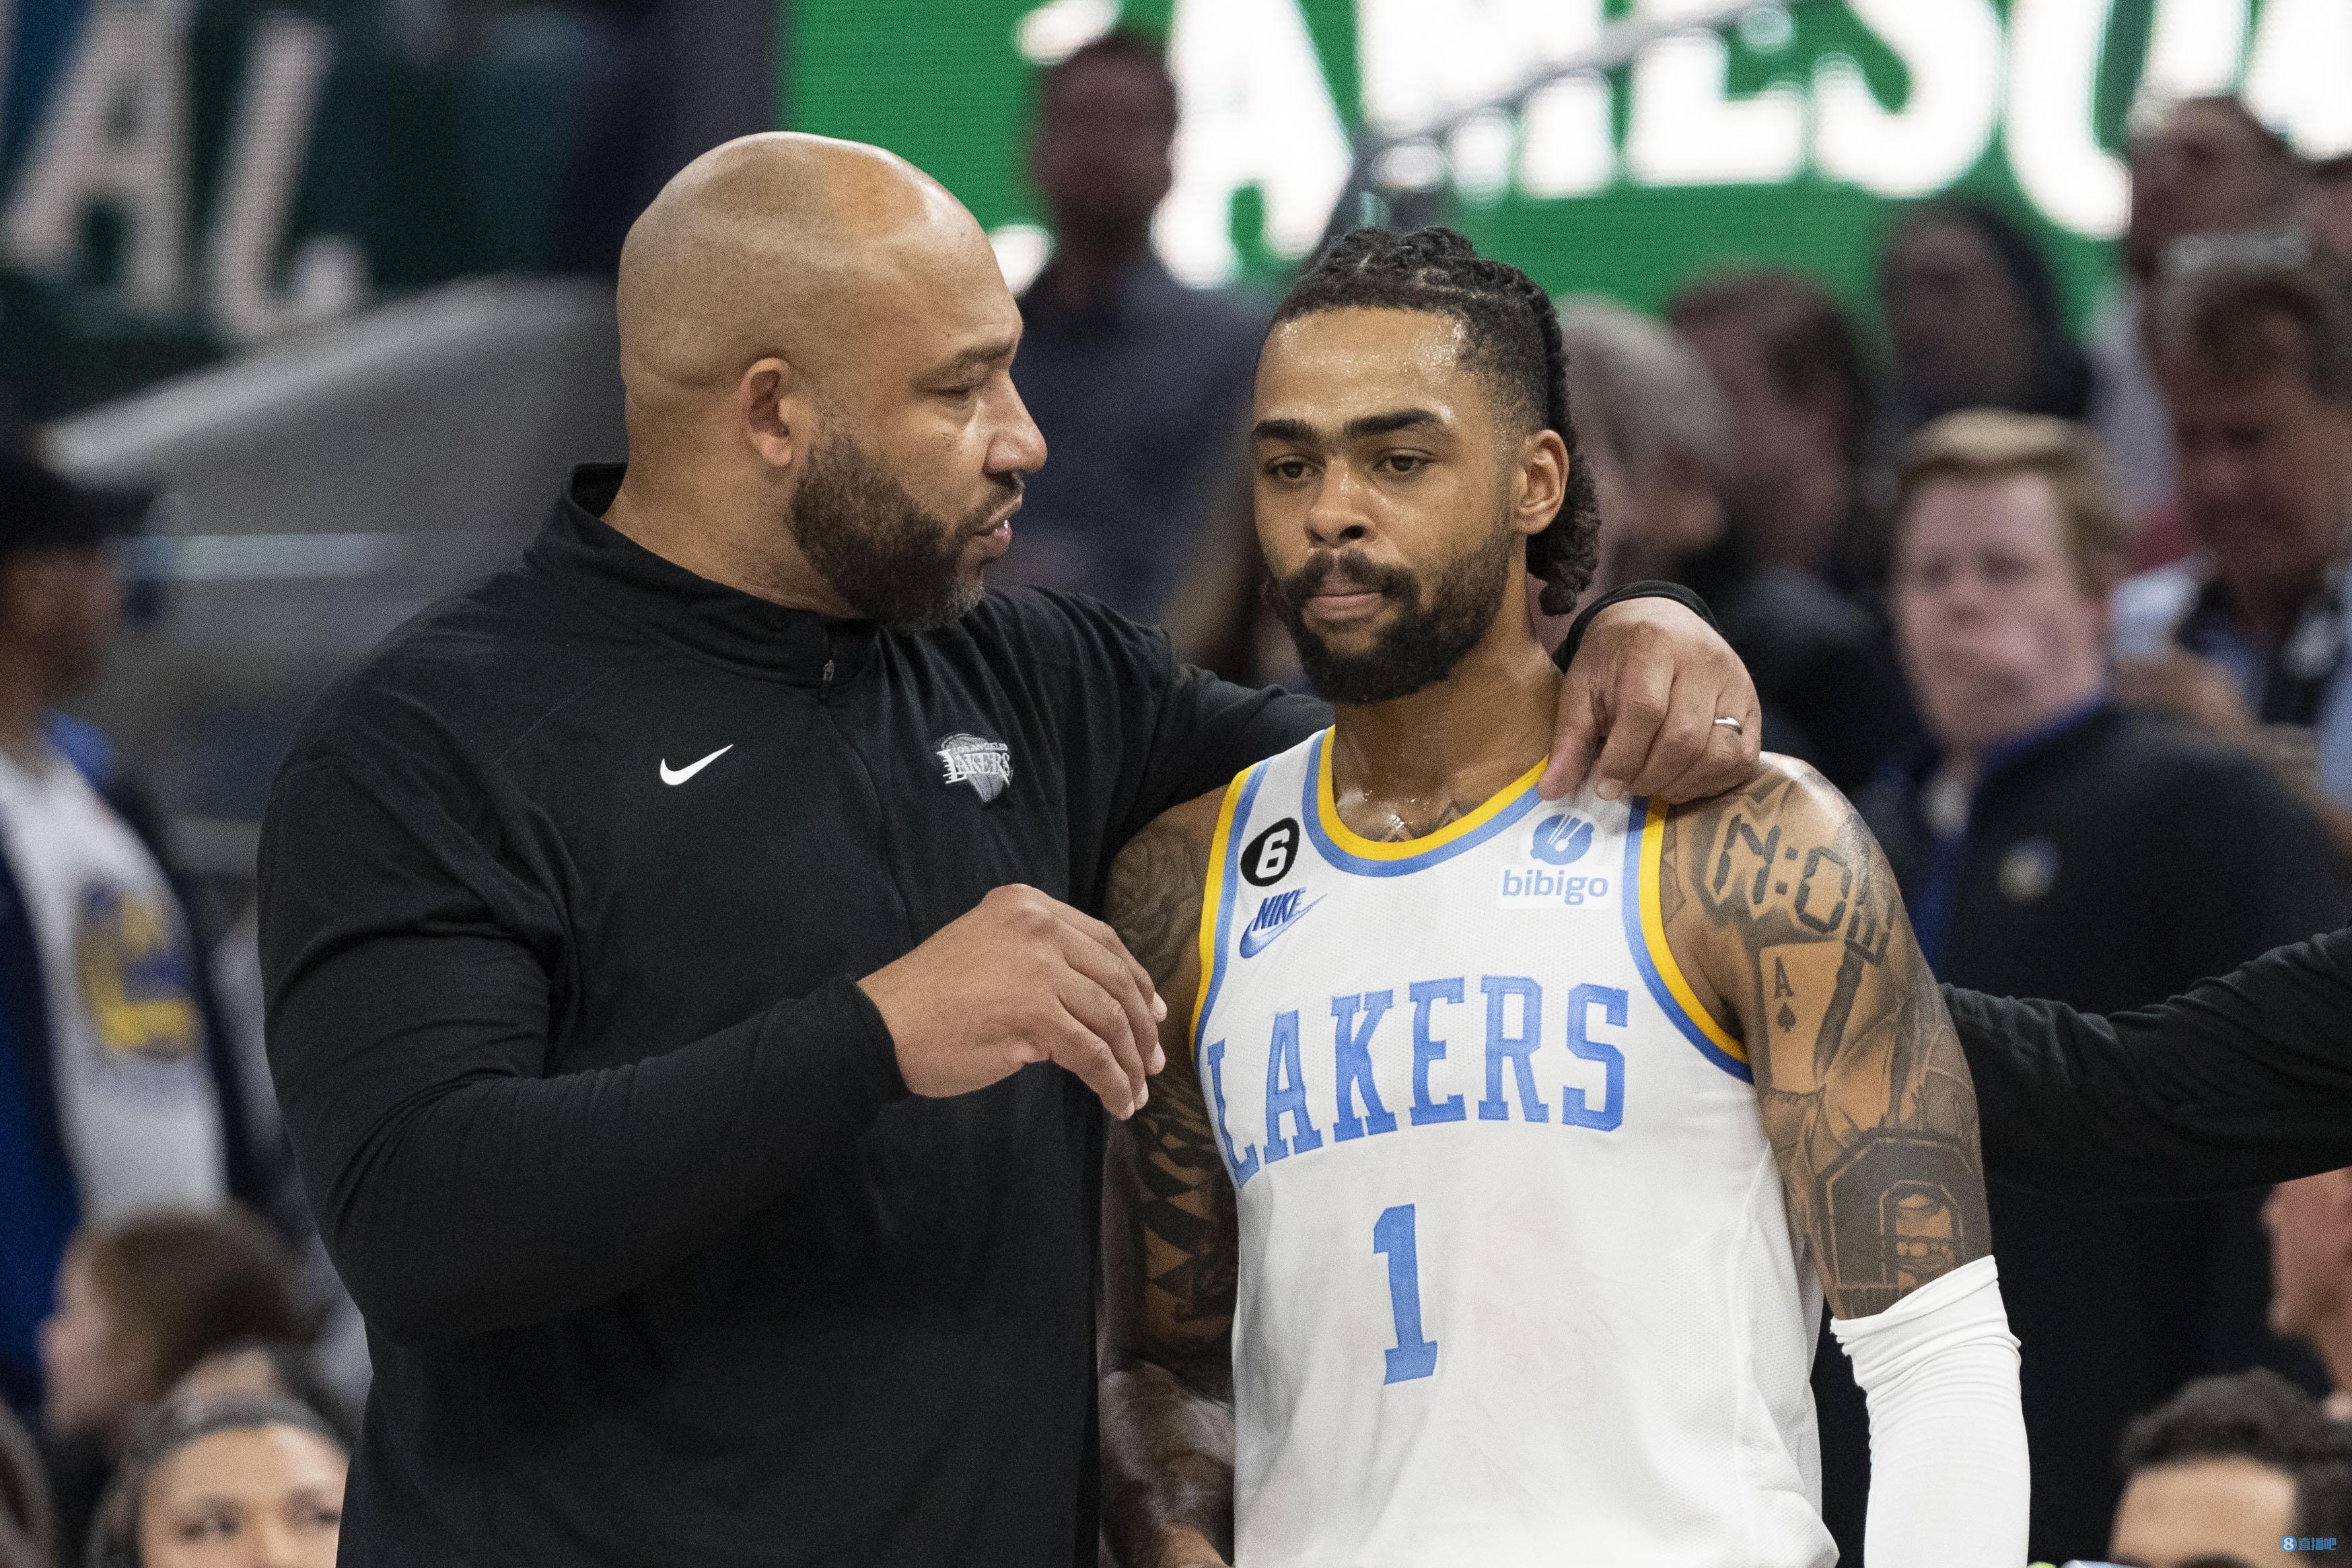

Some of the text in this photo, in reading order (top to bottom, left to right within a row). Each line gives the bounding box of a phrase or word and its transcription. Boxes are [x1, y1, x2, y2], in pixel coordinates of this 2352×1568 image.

[986, 0, 2352, 286] AMESO
[936, 748, 1011, 786] LAKERS
[1255, 828, 1291, 879] 6
[1252, 886, 1307, 932] NIKE
[1502, 869, 1609, 906] bibigo
[1774, 956, 1795, 999] A
[1207, 974, 1629, 1190] LAKERS
[1373, 1202, 1438, 1386] 1
